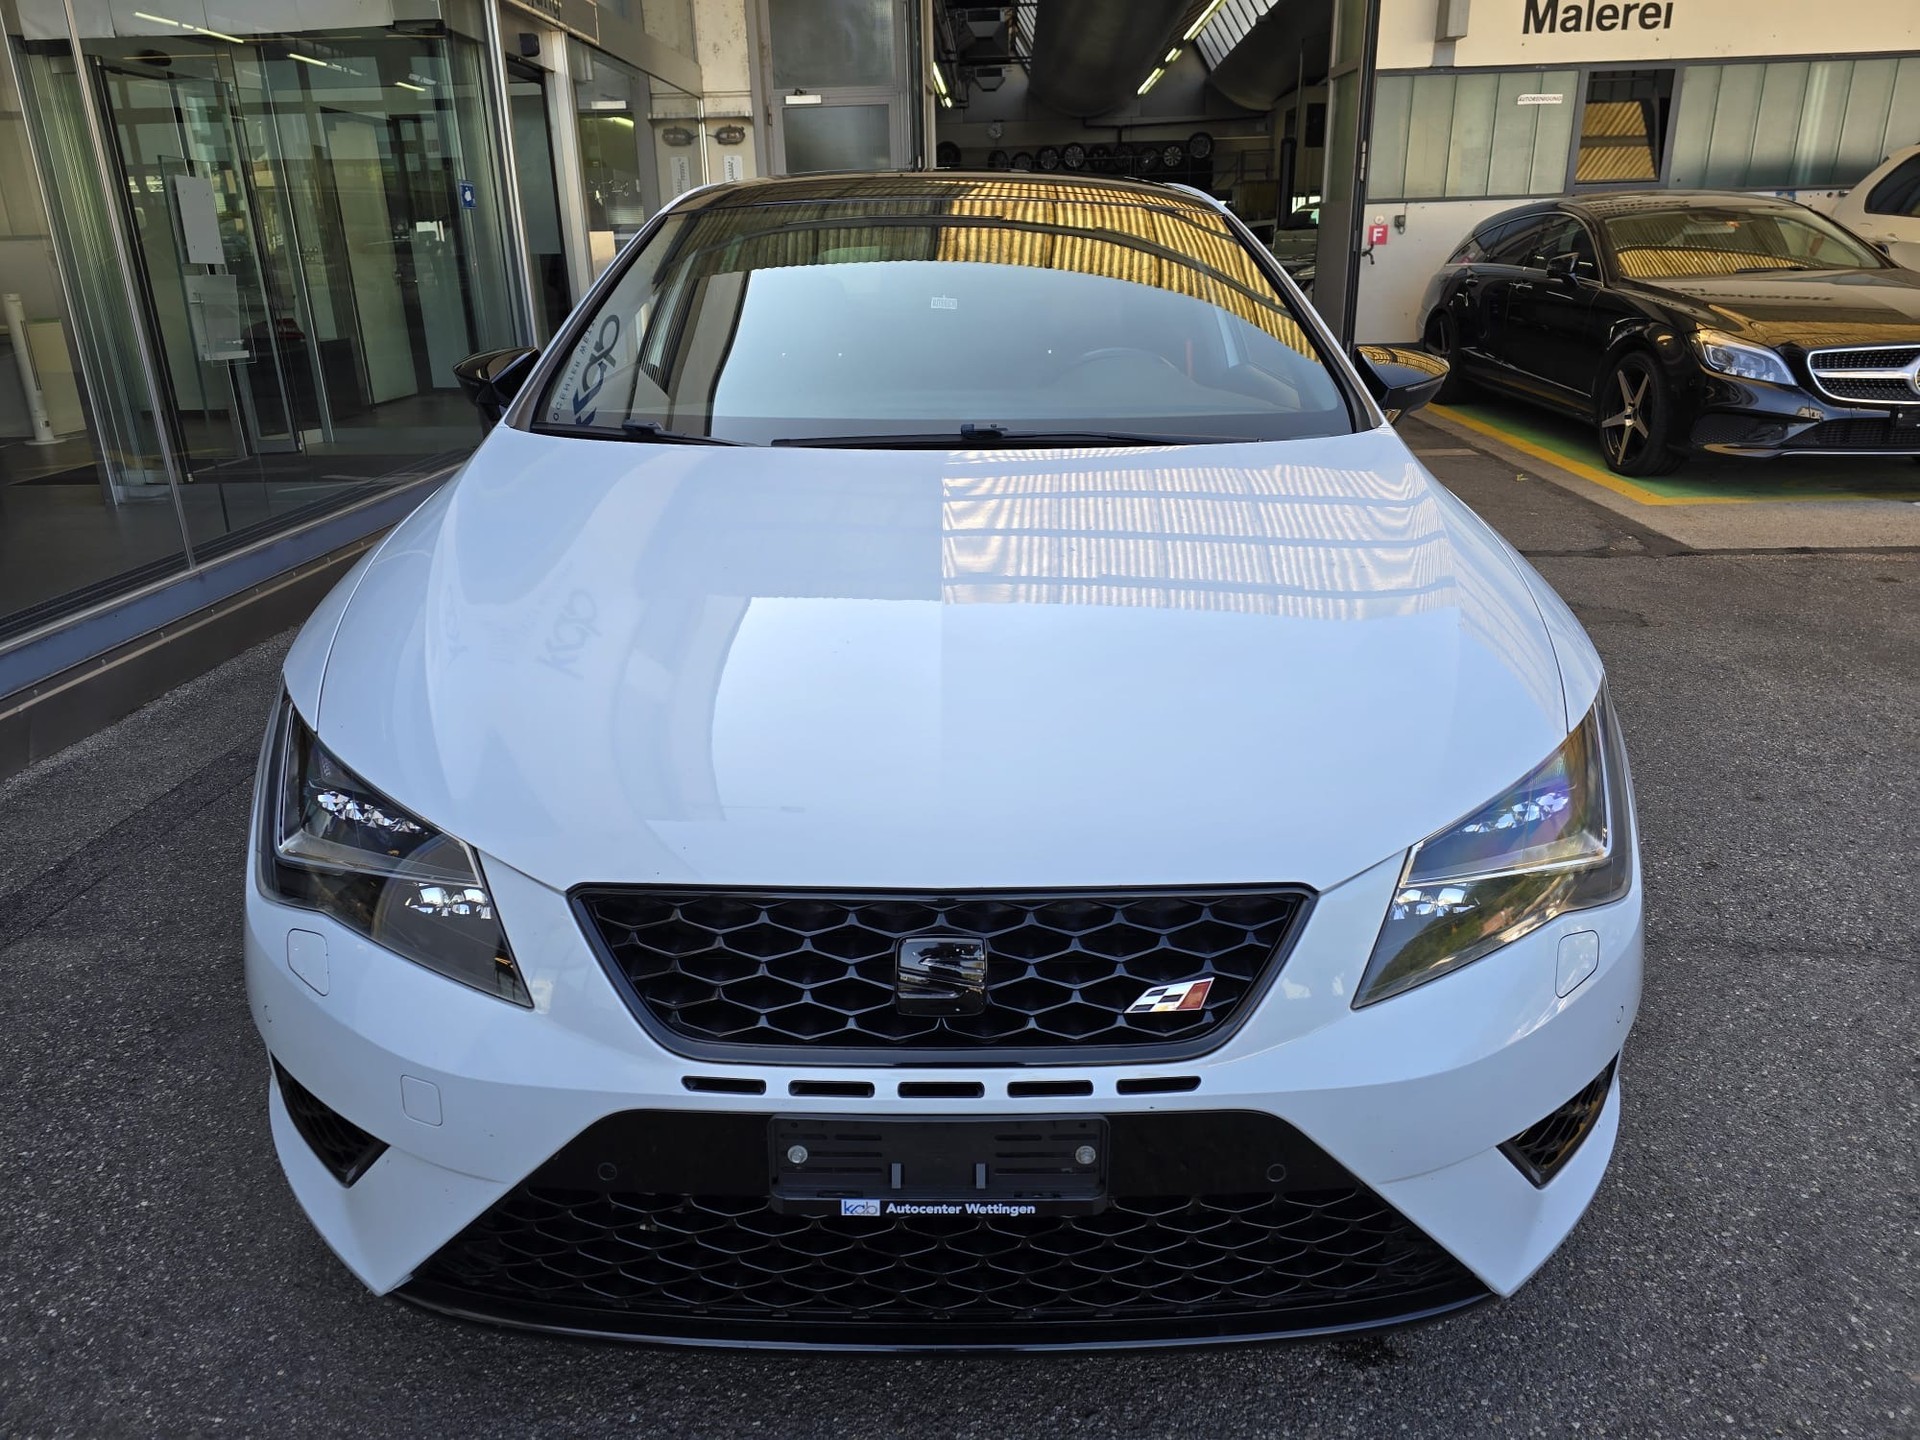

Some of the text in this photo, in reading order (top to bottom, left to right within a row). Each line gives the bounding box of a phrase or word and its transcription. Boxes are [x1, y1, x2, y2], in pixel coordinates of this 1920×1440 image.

[1522, 0, 1674, 35] Malerei
[1372, 227, 1384, 242] F
[886, 1203, 962, 1215] Autocenter
[965, 1203, 1036, 1217] Wettingen
